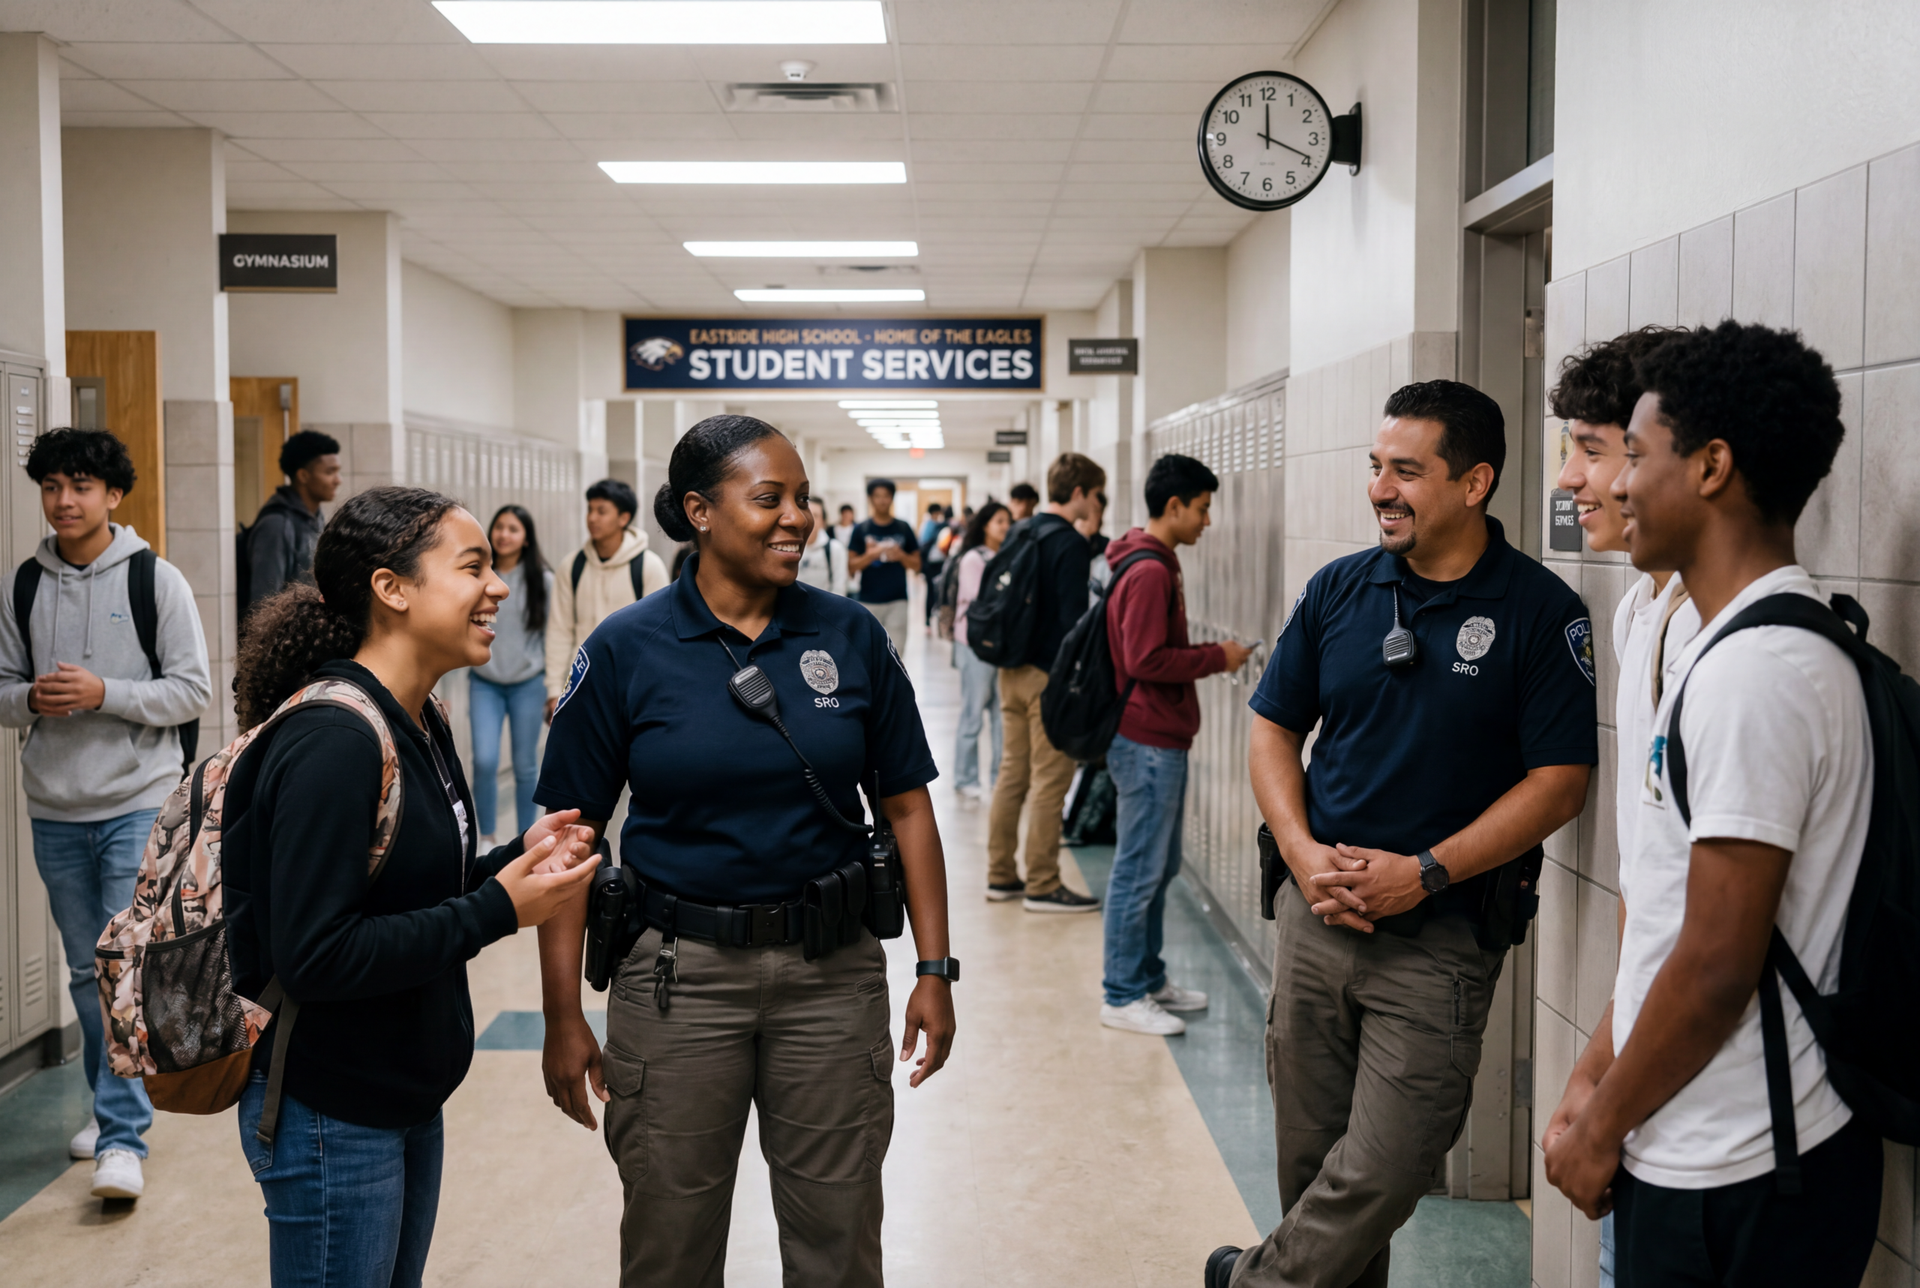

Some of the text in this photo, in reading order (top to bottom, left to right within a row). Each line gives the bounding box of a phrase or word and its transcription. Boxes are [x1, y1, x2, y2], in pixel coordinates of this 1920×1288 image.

[1238, 93, 1252, 107] 11
[1259, 87, 1276, 101] 12
[1287, 93, 1294, 107] 1
[1222, 110, 1240, 124] 10
[1302, 109, 1312, 123] 2
[1216, 132, 1227, 146] 9
[1308, 132, 1319, 146] 3
[1223, 155, 1233, 168] 8
[1301, 155, 1312, 168] 4
[1240, 172, 1250, 185] 7
[1262, 178, 1273, 191] 6
[1285, 171, 1296, 185] 5
[233, 254, 329, 268] GYMNASIUM
[689, 328, 760, 345] EASTSIDE
[762, 328, 800, 345] HIGH
[801, 328, 863, 345] SCHOOL
[874, 328, 918, 345] HOME
[919, 328, 942, 345] OF
[944, 328, 974, 345] THE
[975, 328, 1033, 345] EAGLES
[688, 349, 1034, 381] STUDENT SERVICES
[1451, 661, 1479, 677] SRO
[814, 696, 840, 708] SRO
